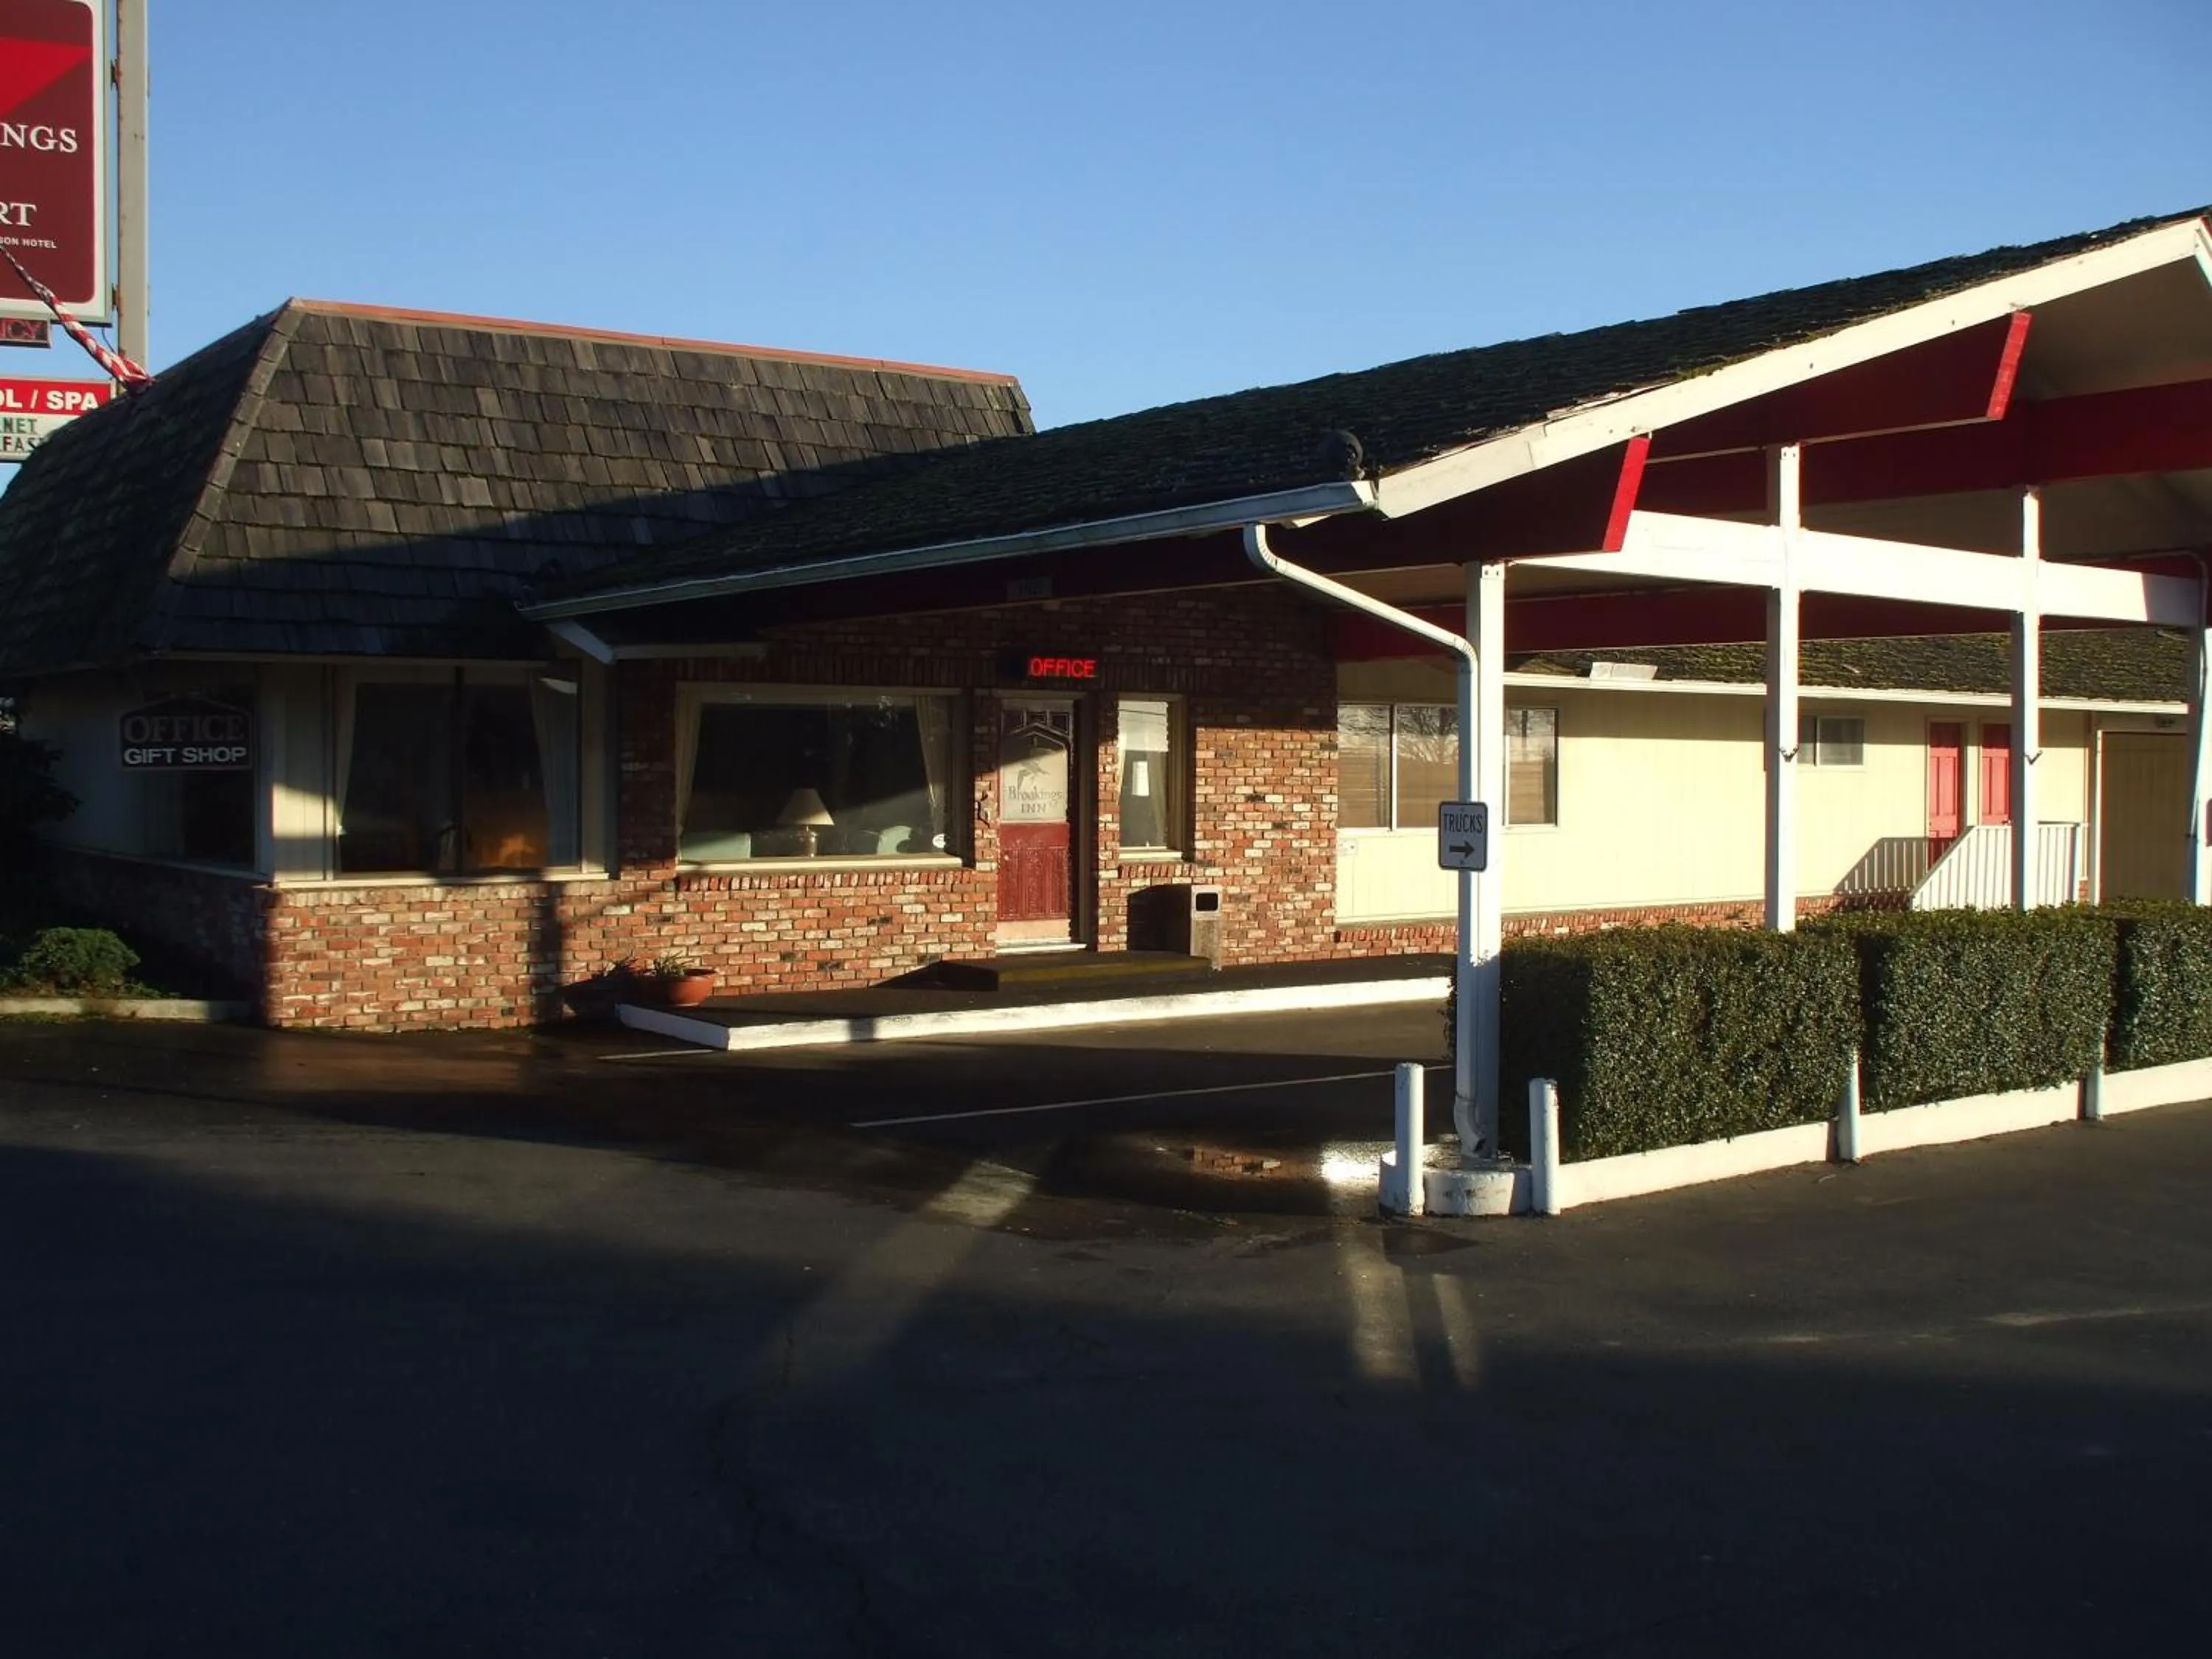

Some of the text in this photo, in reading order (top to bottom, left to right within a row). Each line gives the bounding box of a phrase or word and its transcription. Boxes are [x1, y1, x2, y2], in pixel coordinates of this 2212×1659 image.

[0, 122, 77, 153] NGS
[22, 238, 58, 249] HOTEL
[46, 390, 99, 411] SPA
[0, 417, 38, 435] NET
[1029, 657, 1097, 678] OFFICE
[123, 715, 246, 743] OFFICE
[123, 746, 247, 765] GIFT SHOP
[1020, 803, 1047, 814] INN
[1444, 813, 1483, 833] TRUCKS
